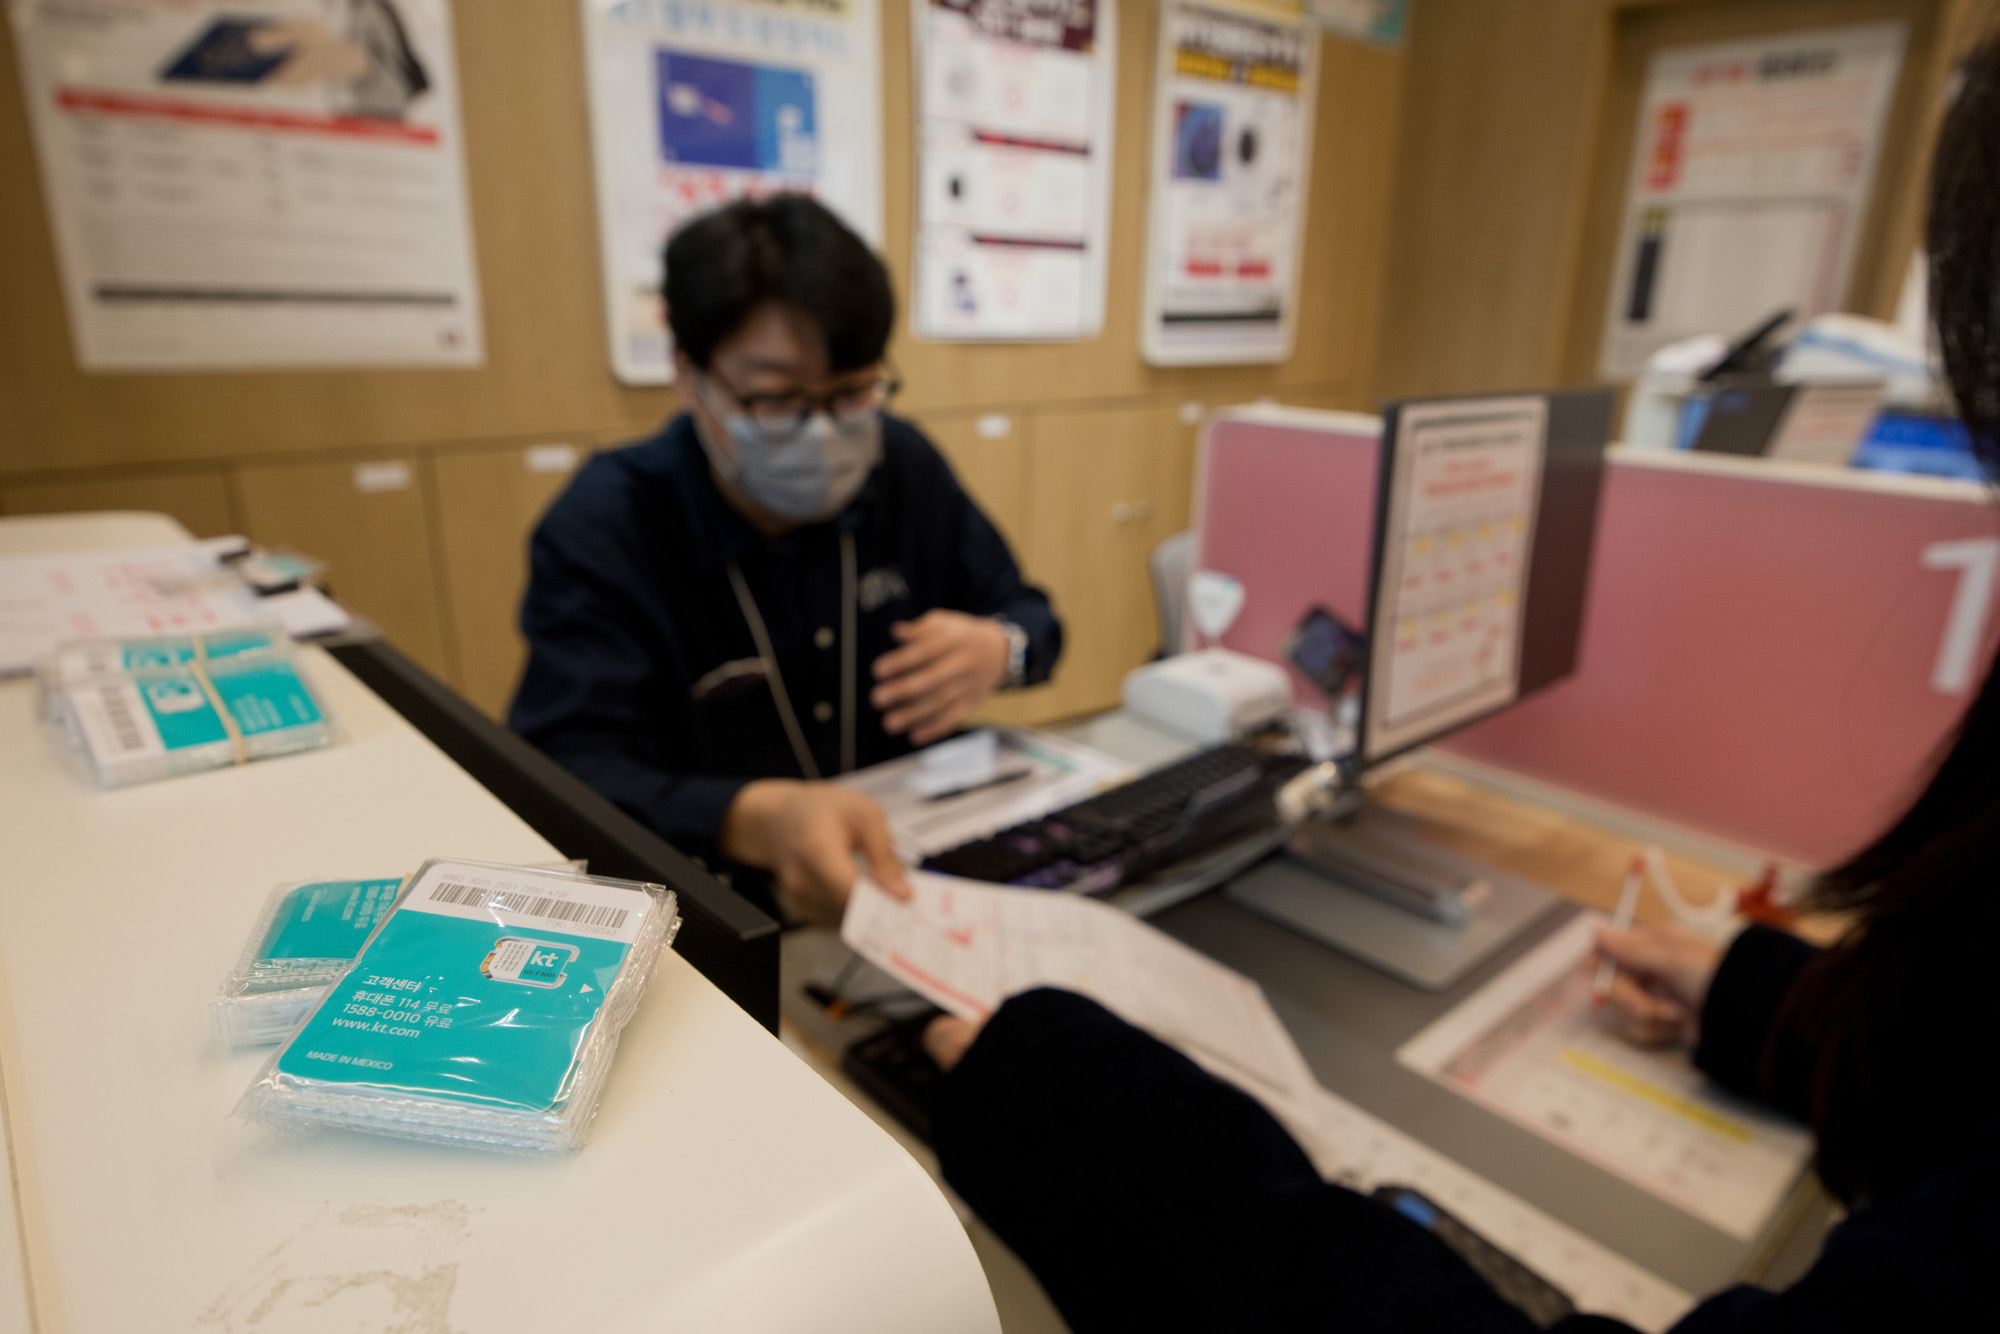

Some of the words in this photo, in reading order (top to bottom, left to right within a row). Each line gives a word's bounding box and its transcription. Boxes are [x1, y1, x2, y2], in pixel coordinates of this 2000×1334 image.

[1919, 536, 2000, 696] 1
[530, 950, 559, 968] kt
[362, 974, 423, 993] 고객센터
[351, 990, 397, 1007] 휴대폰
[398, 998, 422, 1010] 114
[423, 1001, 454, 1015] 무료
[342, 1003, 422, 1024] 1588-0010
[423, 1015, 454, 1029] 유료
[332, 1018, 421, 1039] www.kt.com
[305, 1050, 340, 1063] MADE
[338, 1055, 352, 1065] IN
[350, 1056, 394, 1071] MEXICO
